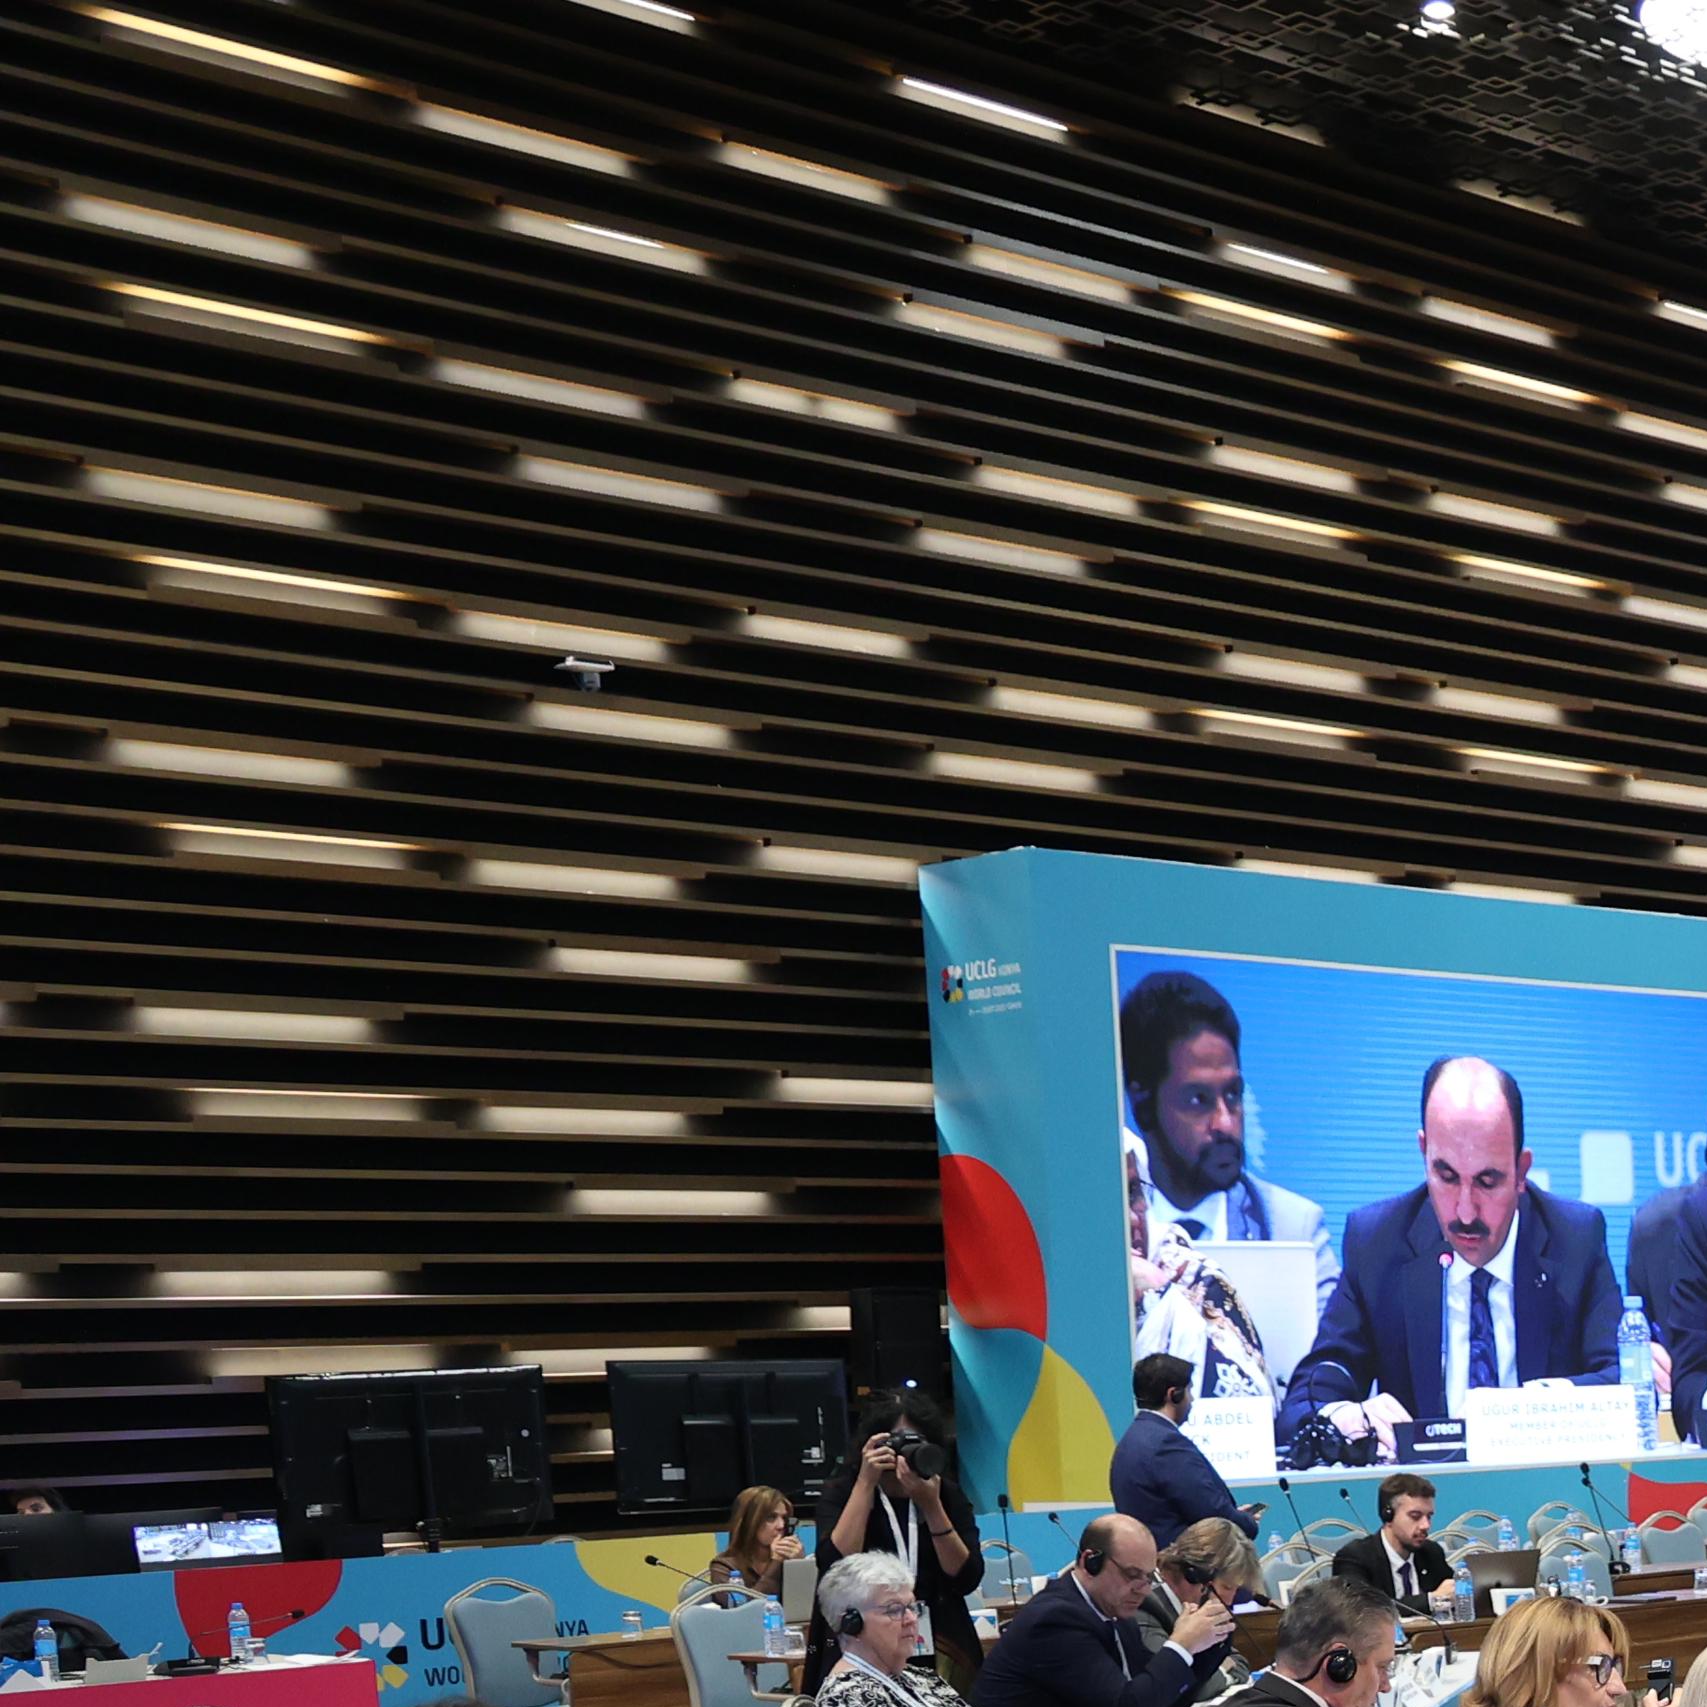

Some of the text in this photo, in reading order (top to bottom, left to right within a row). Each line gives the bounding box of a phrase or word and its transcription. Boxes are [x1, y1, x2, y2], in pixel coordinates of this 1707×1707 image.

[965, 958, 998, 981] UCLG
[1203, 1411, 1255, 1426] ABDEL
[424, 1666, 466, 1688] WO
